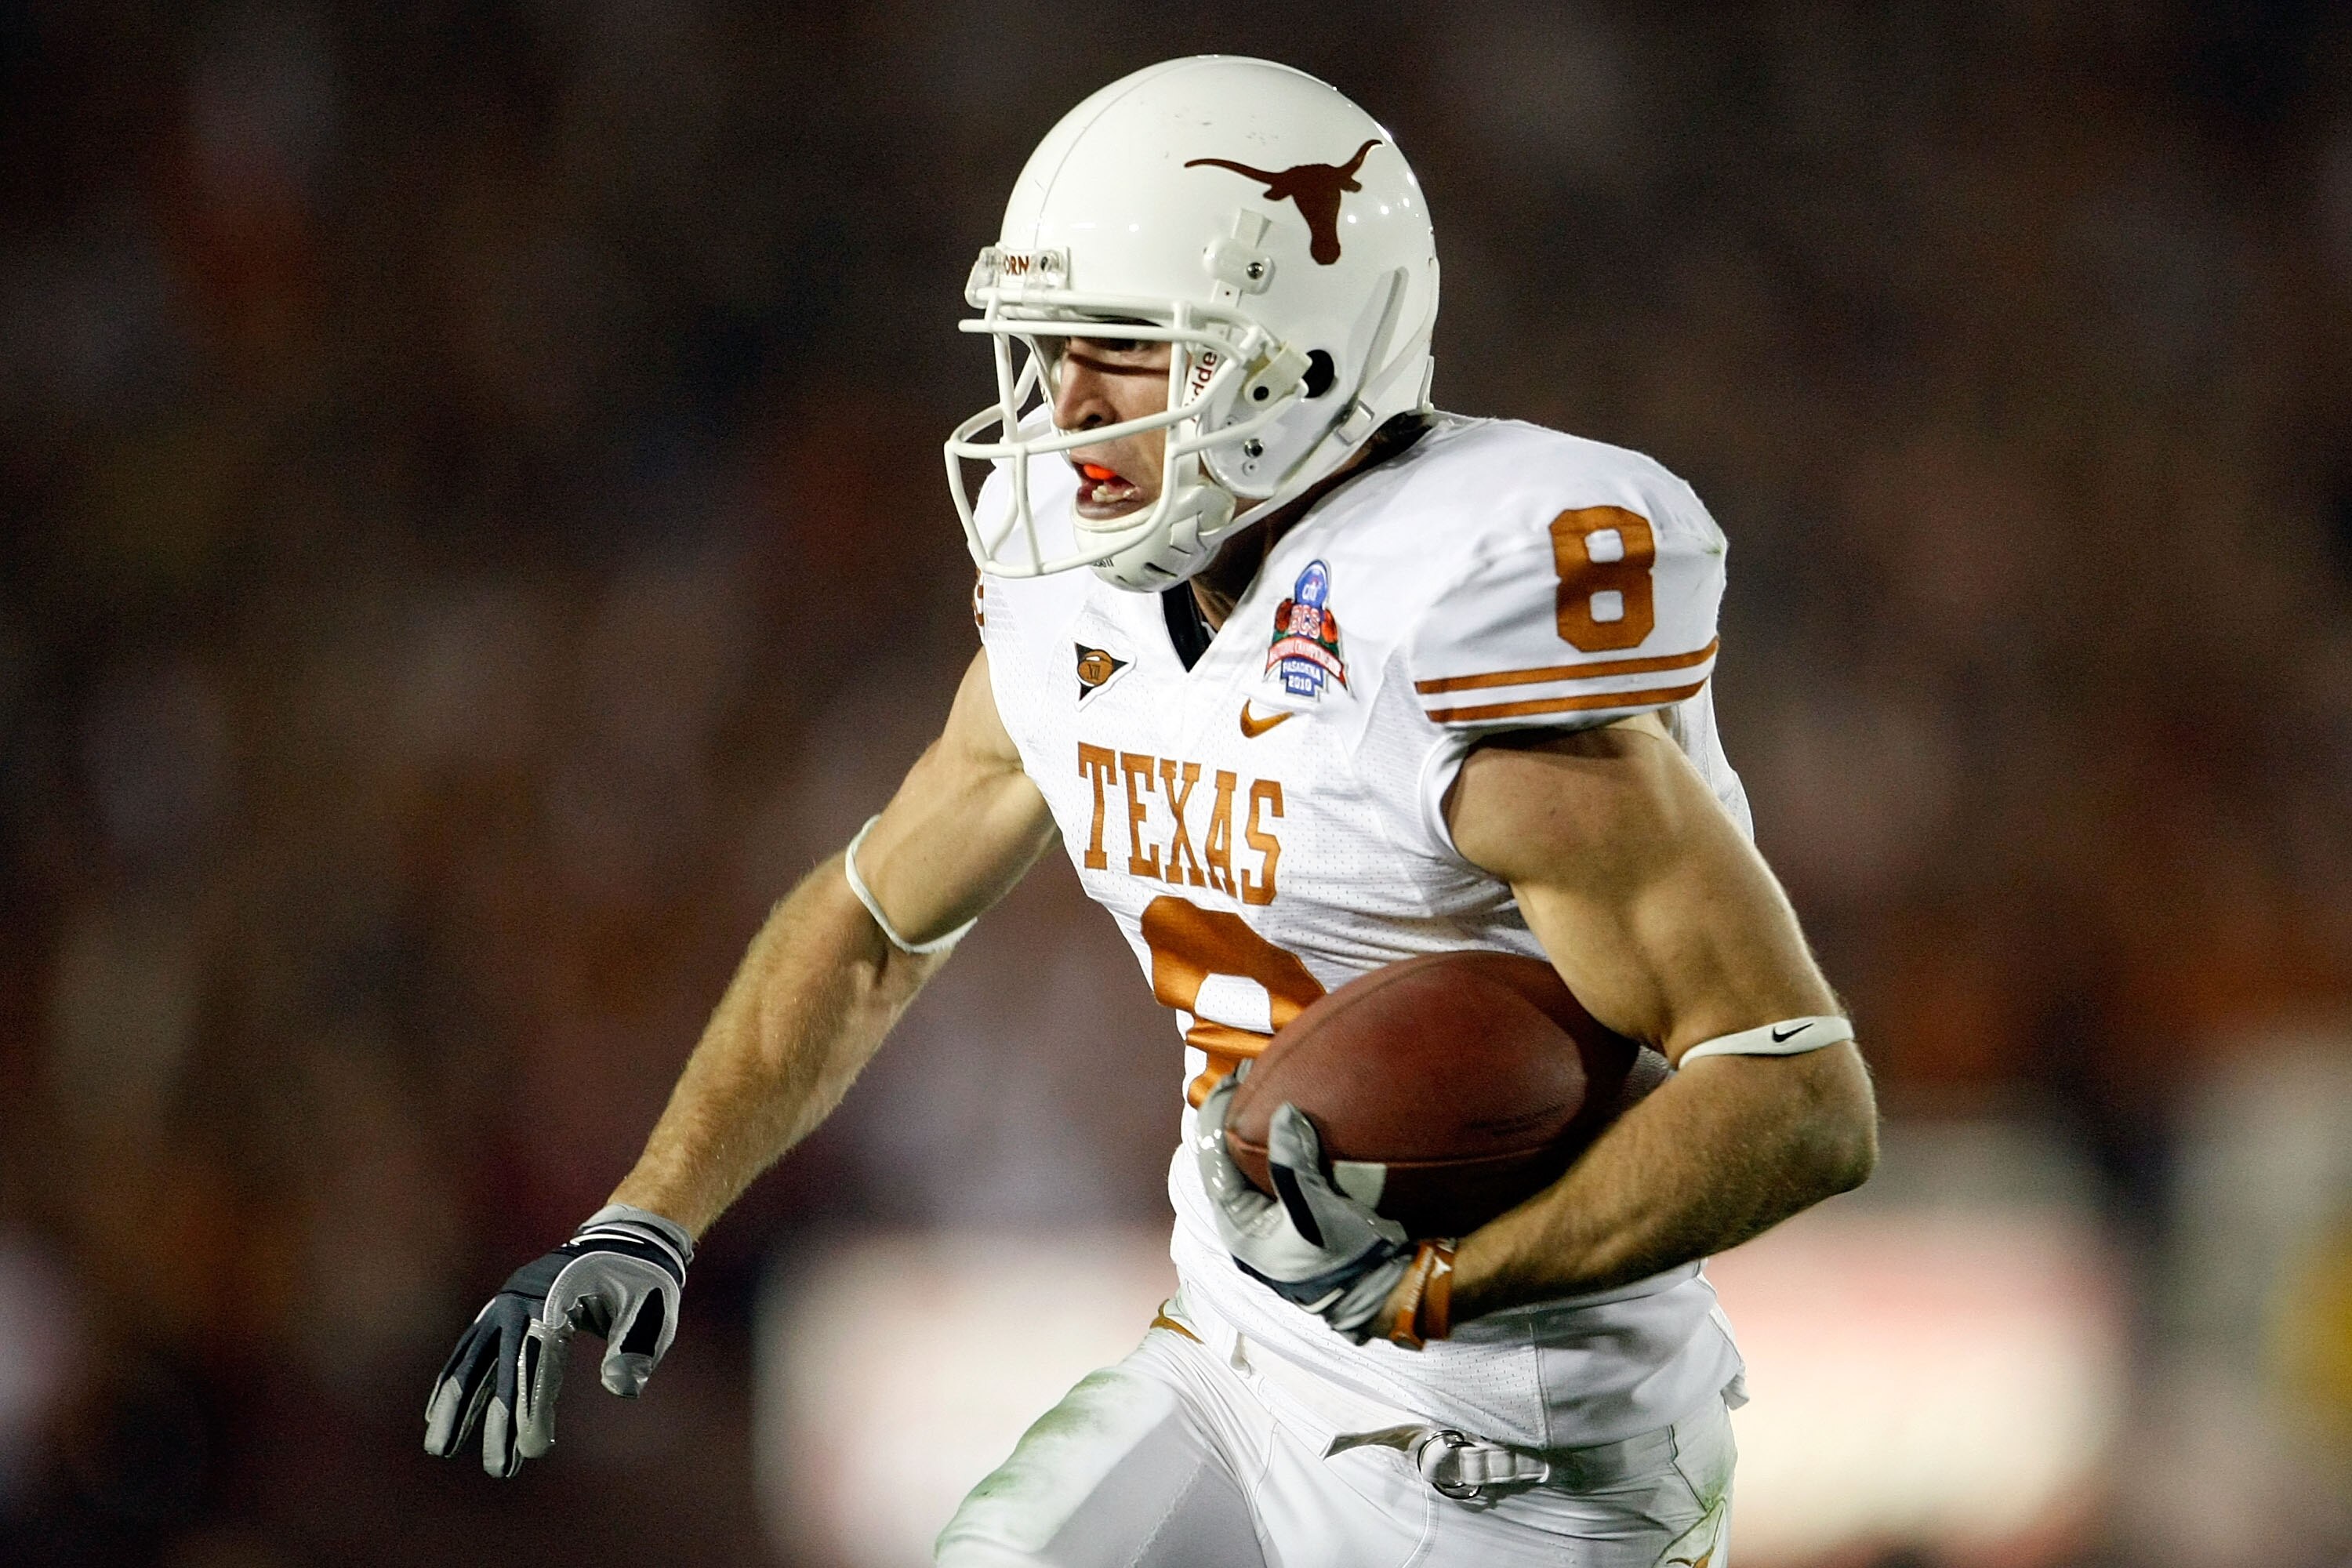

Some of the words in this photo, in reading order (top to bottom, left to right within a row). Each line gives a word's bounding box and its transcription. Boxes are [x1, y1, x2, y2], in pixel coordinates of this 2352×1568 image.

[1548, 505, 1655, 652] 8
[1288, 675, 1312, 692] 2010
[1078, 742, 1284, 906] TEXAS
